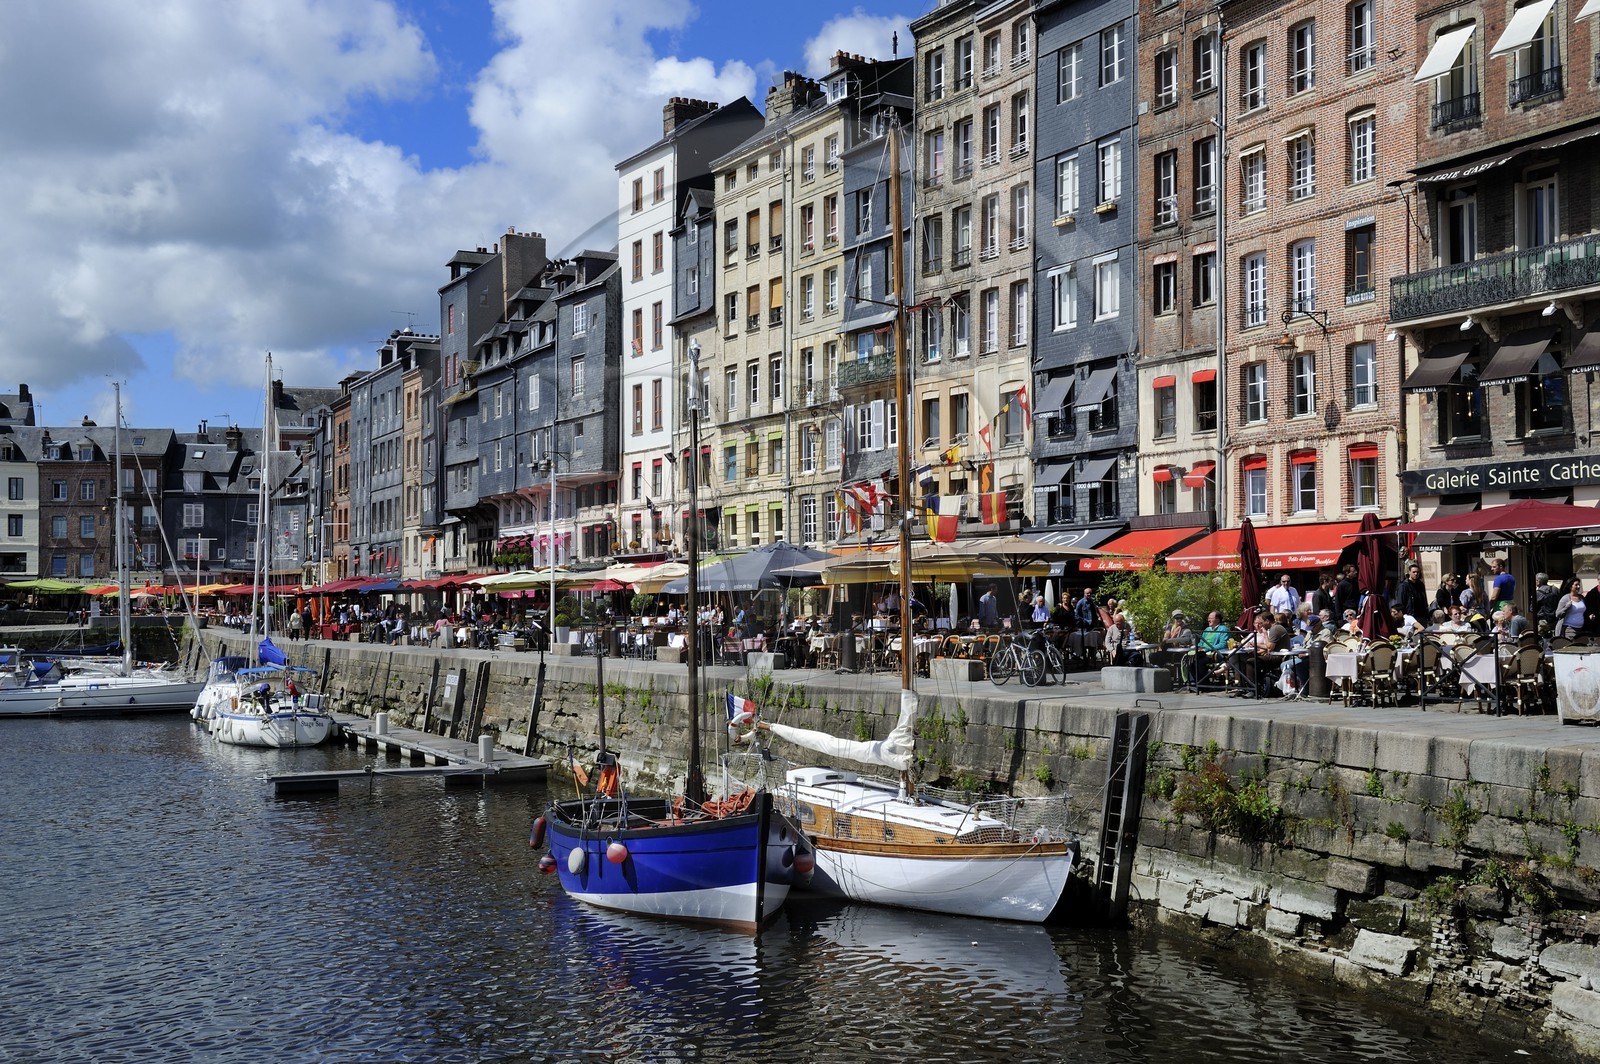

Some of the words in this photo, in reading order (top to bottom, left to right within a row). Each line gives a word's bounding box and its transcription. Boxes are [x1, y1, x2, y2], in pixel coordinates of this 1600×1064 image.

[1346, 215, 1375, 228] Inspiration
[1425, 471, 1480, 490] Galerie
[1488, 466, 1540, 486] Sainte
[1549, 460, 1600, 481] Cathe
[1260, 559, 1282, 568] Marin
